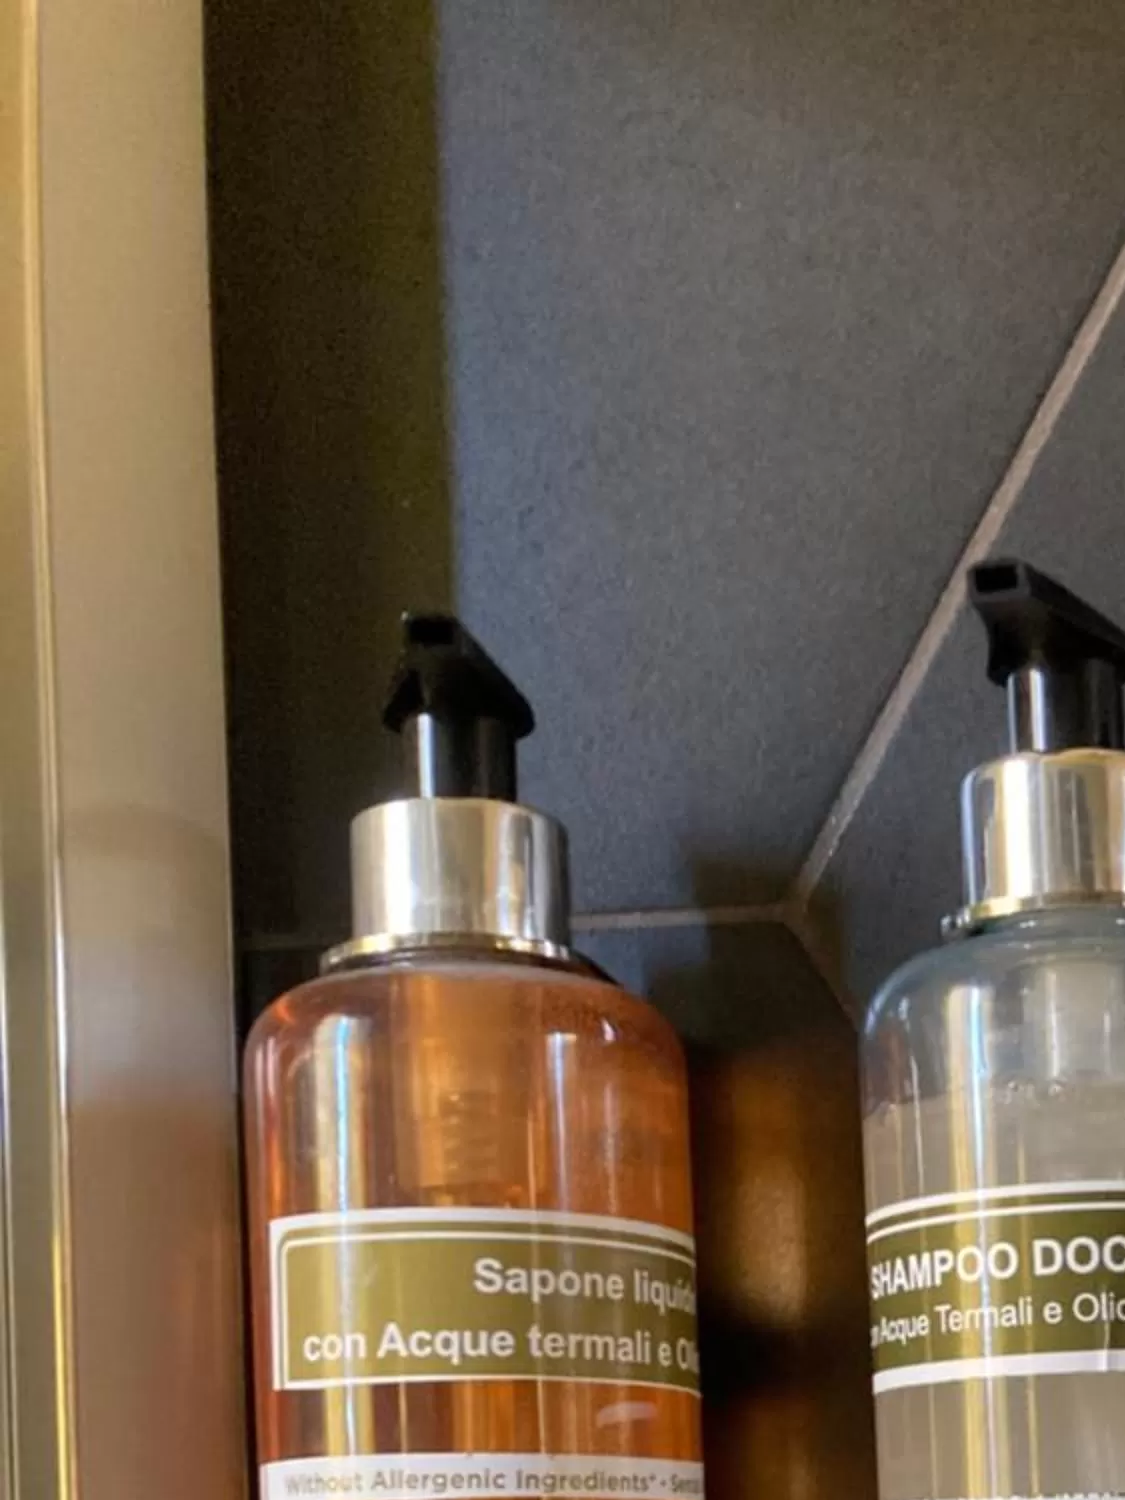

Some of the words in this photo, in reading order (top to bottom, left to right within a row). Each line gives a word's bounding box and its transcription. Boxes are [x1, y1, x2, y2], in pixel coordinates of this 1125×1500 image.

[473, 1256, 625, 1304] Sapone
[870, 1242, 1019, 1300] SHAMPOO
[933, 1299, 1033, 1335] Termali
[1043, 1299, 1063, 1325] e
[303, 1331, 367, 1363] con
[377, 1322, 515, 1366] Acque
[528, 1324, 652, 1366] termali
[658, 1340, 672, 1369] e
[284, 1471, 364, 1497] Without
[370, 1468, 507, 1494] Allergenic
